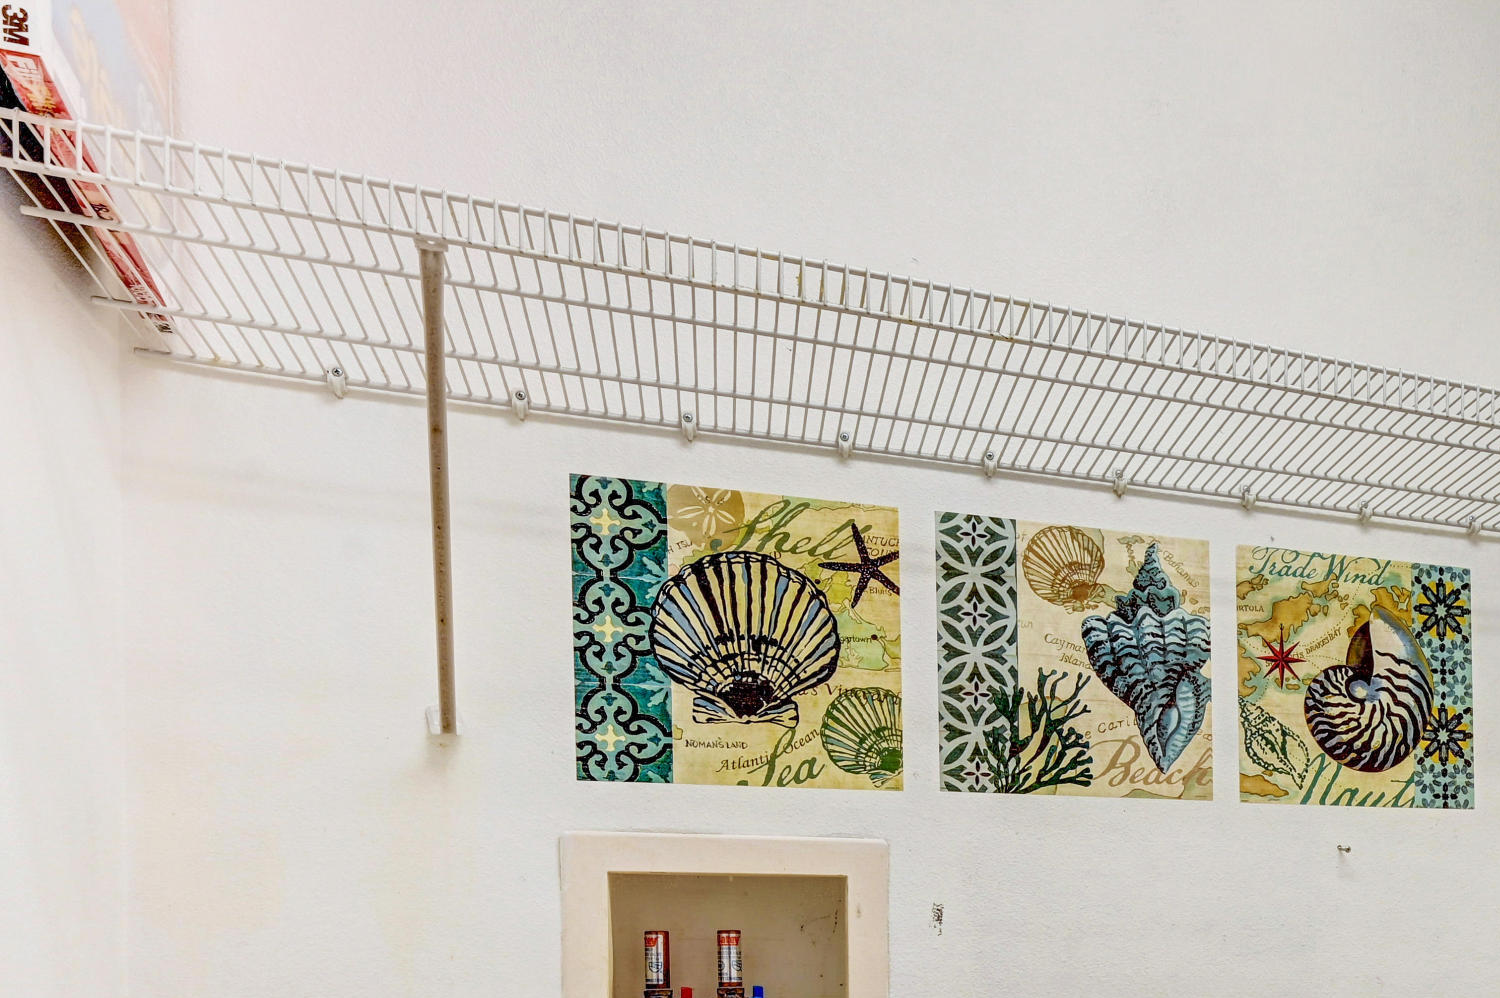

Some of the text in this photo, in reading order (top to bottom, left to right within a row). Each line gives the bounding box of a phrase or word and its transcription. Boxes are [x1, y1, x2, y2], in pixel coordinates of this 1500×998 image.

[2, 4, 30, 46] 3M
[709, 499, 872, 560] Shell
[1162, 550, 1200, 588] Bahamas
[1248, 546, 1392, 585] Trade Wind
[1236, 604, 1265, 613] RTOLA
[716, 750, 771, 773] Atlanti
[736, 728, 826, 788] Sea
[1087, 734, 1213, 788] Beach
[1299, 752, 1415, 807] Naut
